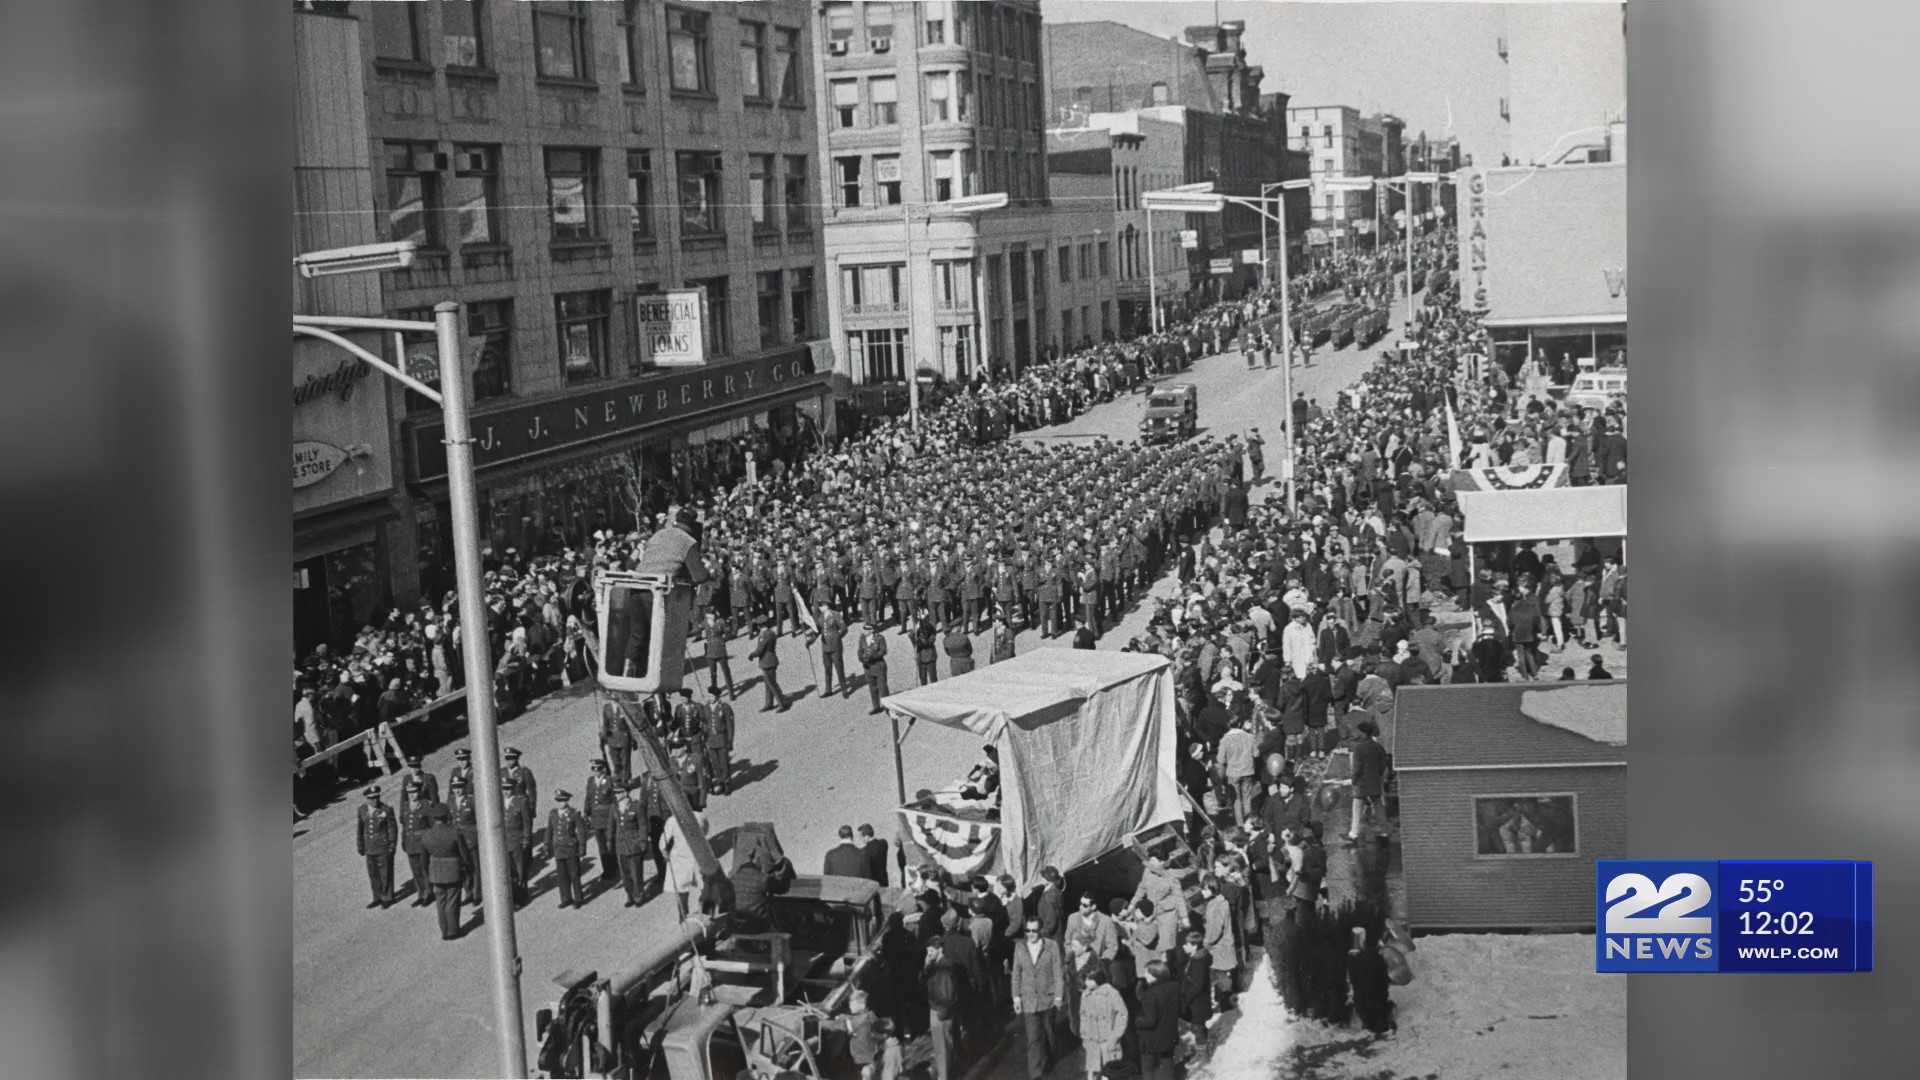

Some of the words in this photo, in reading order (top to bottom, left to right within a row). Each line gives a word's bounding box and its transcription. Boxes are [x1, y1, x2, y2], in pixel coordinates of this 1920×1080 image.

[1468, 173, 1488, 309] GRANTS
[639, 302, 697, 322] BENEFICIAL
[651, 334, 689, 354] LOANS
[481, 427, 501, 451] J.
[528, 416, 548, 440] J.
[574, 371, 755, 430] NEWBERRY
[773, 360, 806, 382] CO.
[293, 449, 318, 464] MILY
[301, 460, 331, 476] STORE
